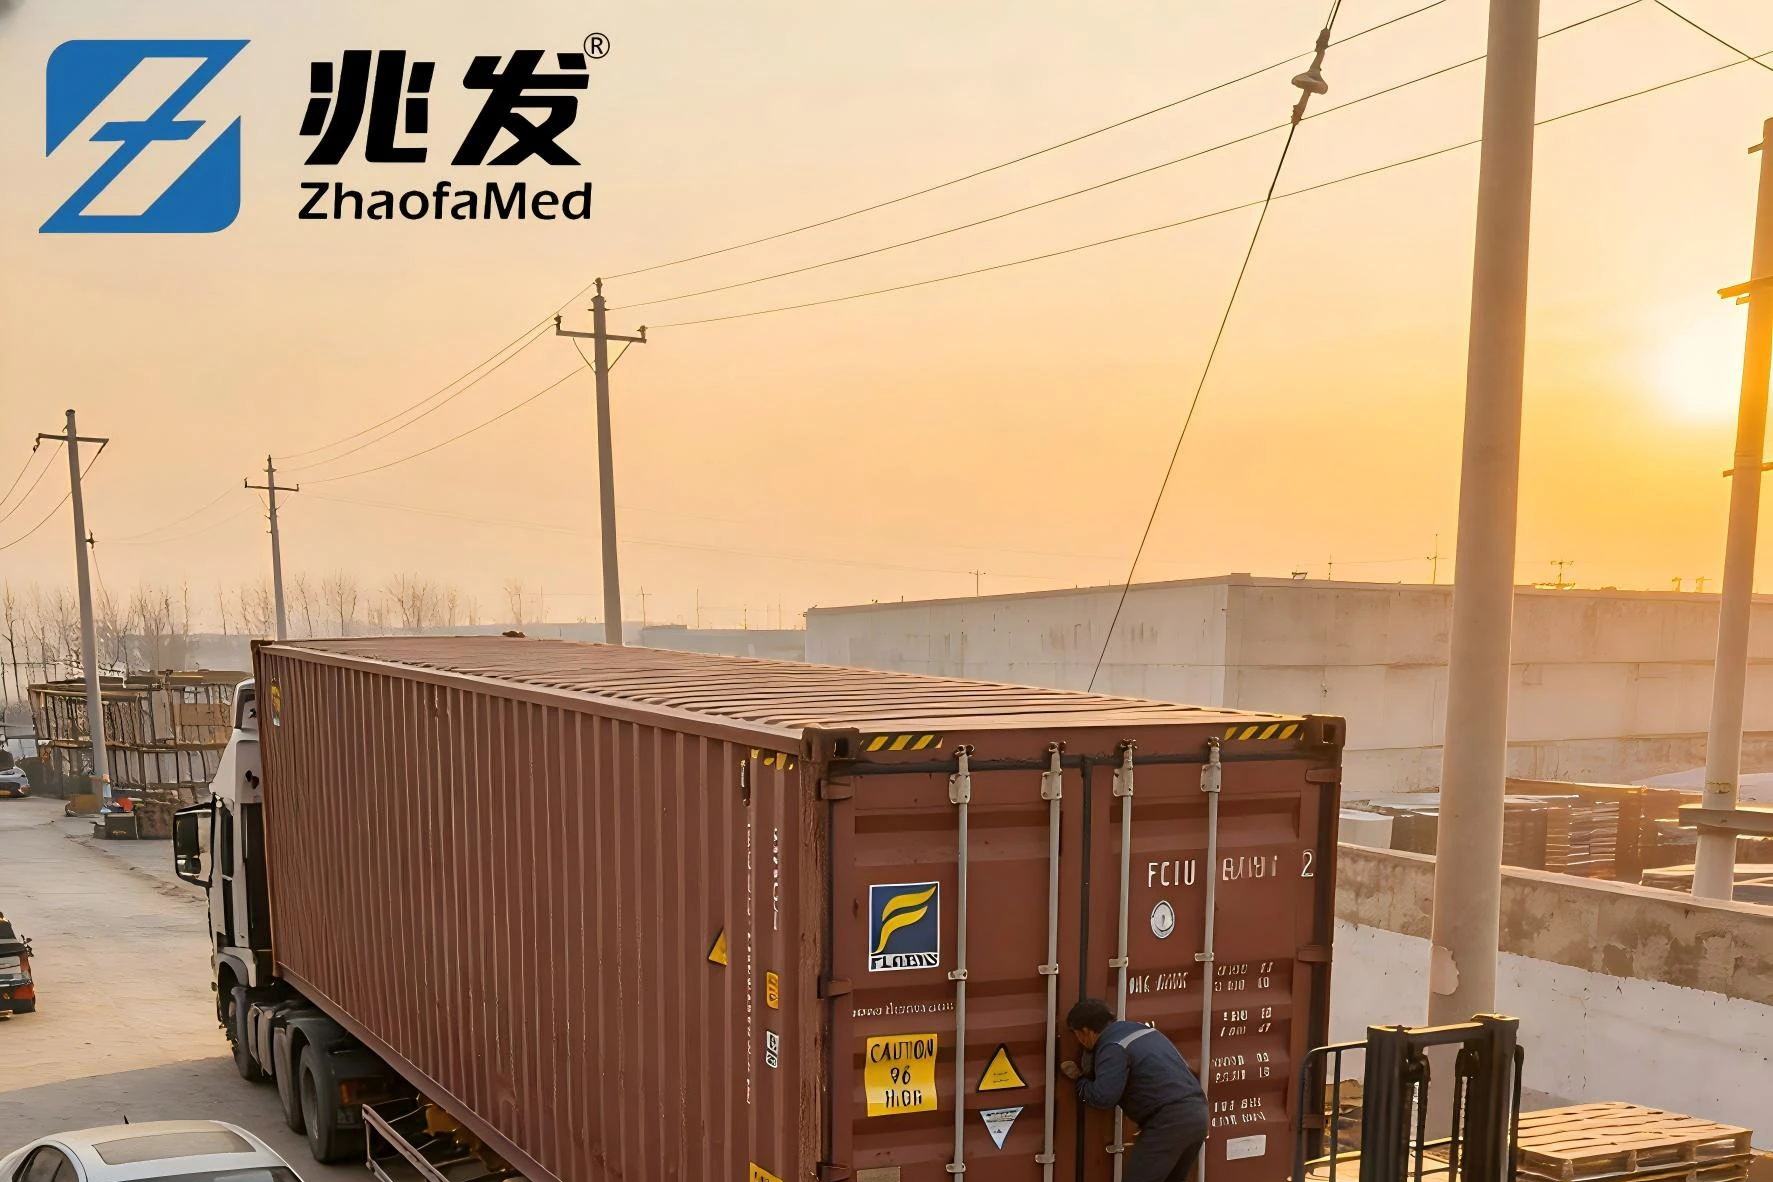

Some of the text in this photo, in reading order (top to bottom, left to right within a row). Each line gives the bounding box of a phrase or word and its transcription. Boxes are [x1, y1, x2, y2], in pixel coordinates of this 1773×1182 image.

[1148, 859, 1196, 888] FCIU
[1301, 850, 1314, 877] 2
[870, 1038, 934, 1064] CAUTION
